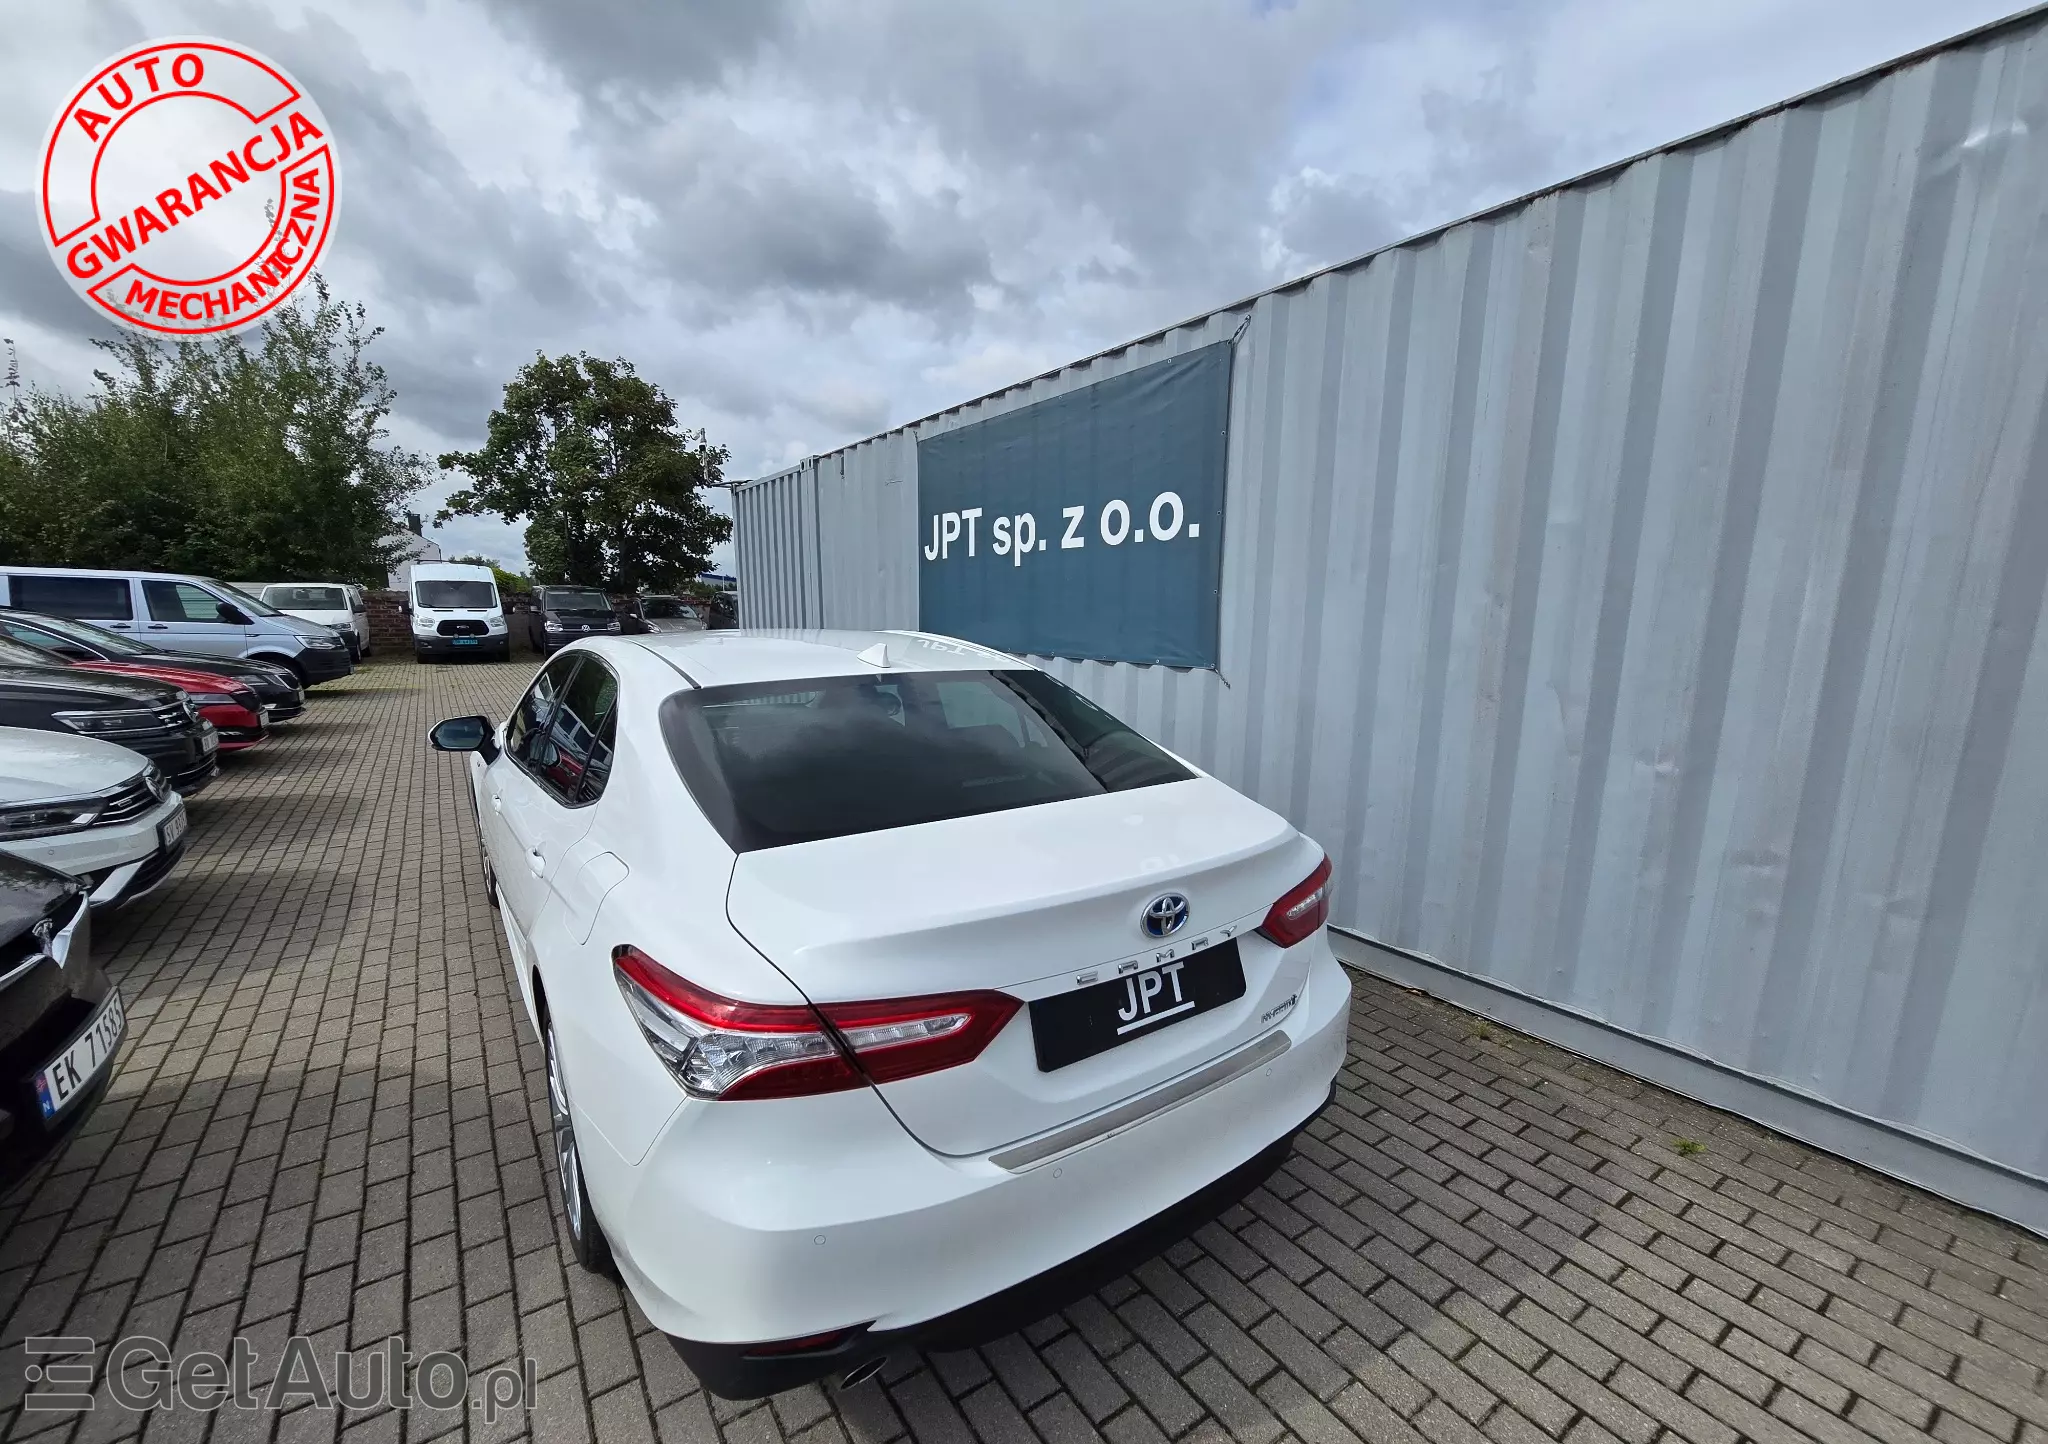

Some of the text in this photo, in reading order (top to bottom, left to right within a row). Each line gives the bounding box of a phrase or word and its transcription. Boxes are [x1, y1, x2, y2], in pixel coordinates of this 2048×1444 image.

[924, 491, 1200, 567] JPT sp. z o.o.
[1118, 961, 1184, 1021] JPT
[52, 997, 122, 1102] EK 71585
